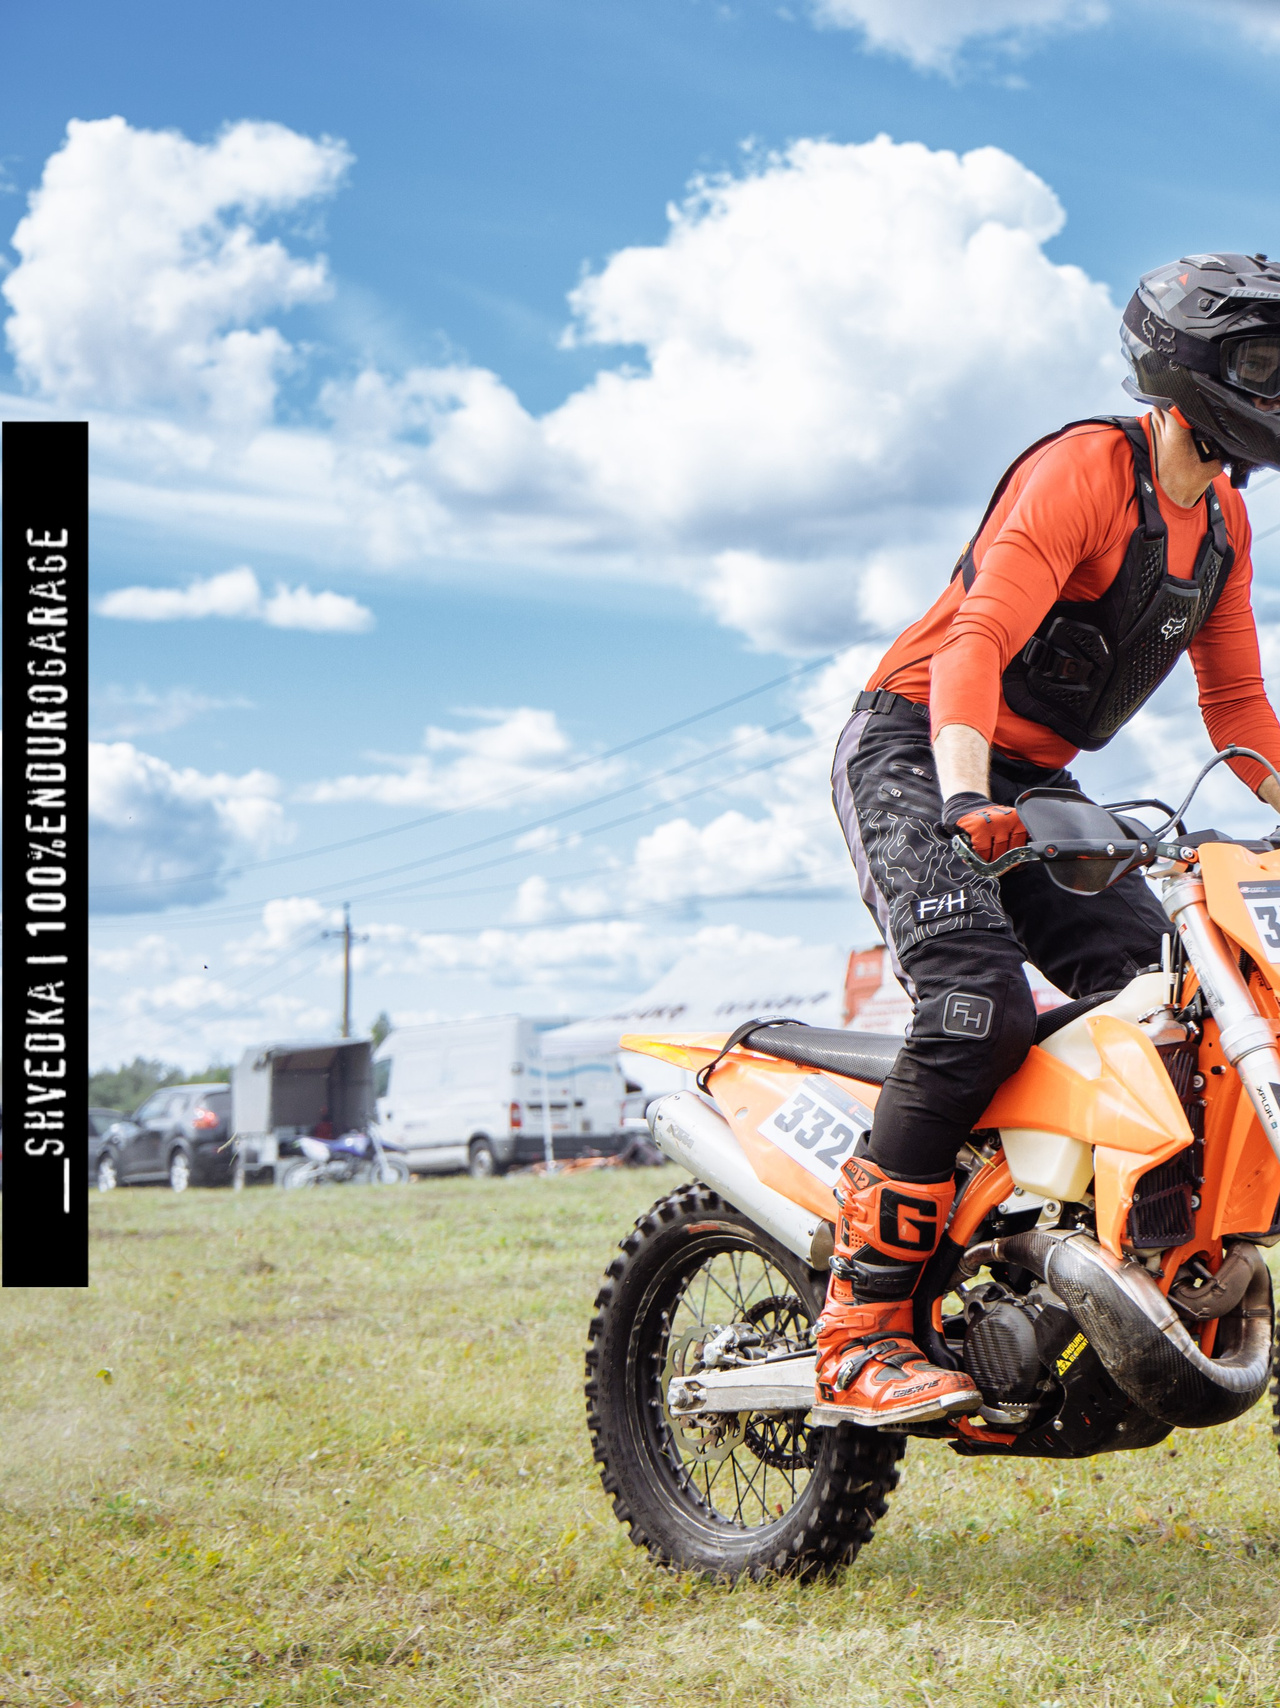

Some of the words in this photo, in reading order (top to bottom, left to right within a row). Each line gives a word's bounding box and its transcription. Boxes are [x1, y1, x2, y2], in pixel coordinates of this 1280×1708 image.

[773, 1092, 856, 1171] 332
[879, 1186, 938, 1253] G
[1060, 1331, 1086, 1360] ENDURO
